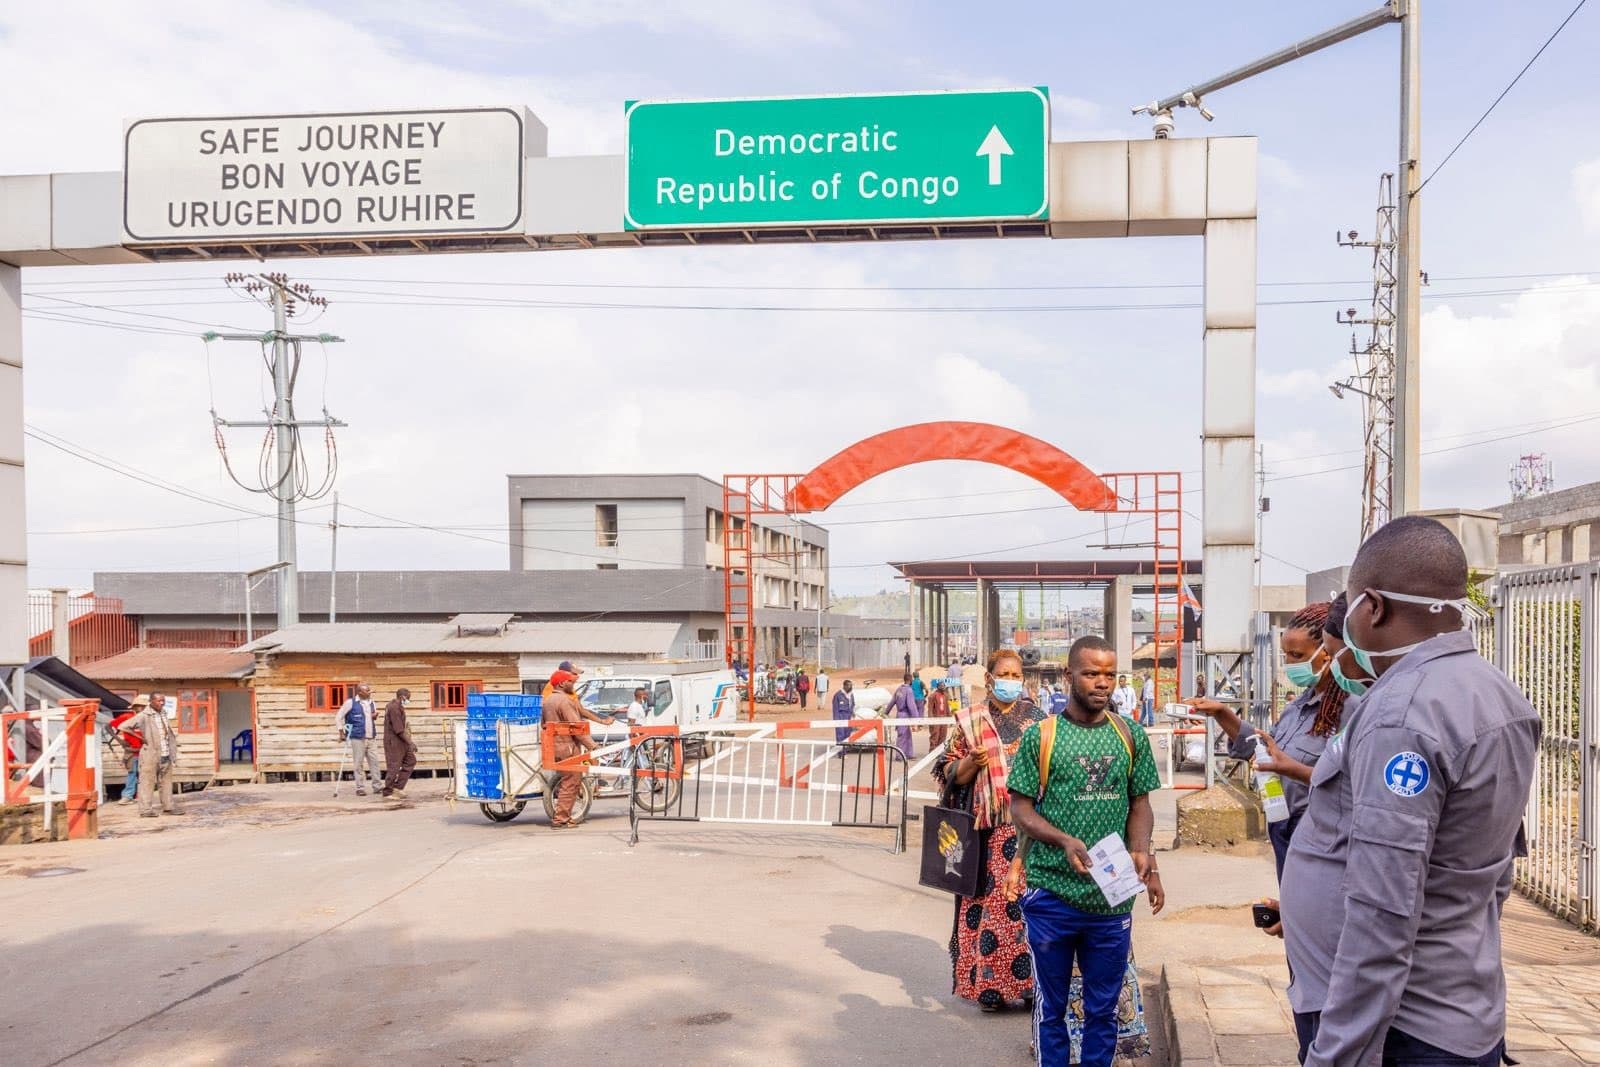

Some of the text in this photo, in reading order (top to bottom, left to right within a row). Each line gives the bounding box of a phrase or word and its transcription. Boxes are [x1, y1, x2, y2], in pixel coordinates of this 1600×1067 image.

[199, 121, 446, 155] SAFE JOURNEY
[715, 124, 898, 157] Democratic
[221, 158, 422, 191] BON VOYAGE
[656, 170, 960, 210] Republic of Congo
[168, 193, 476, 228] URUGENDO RUHIRE
